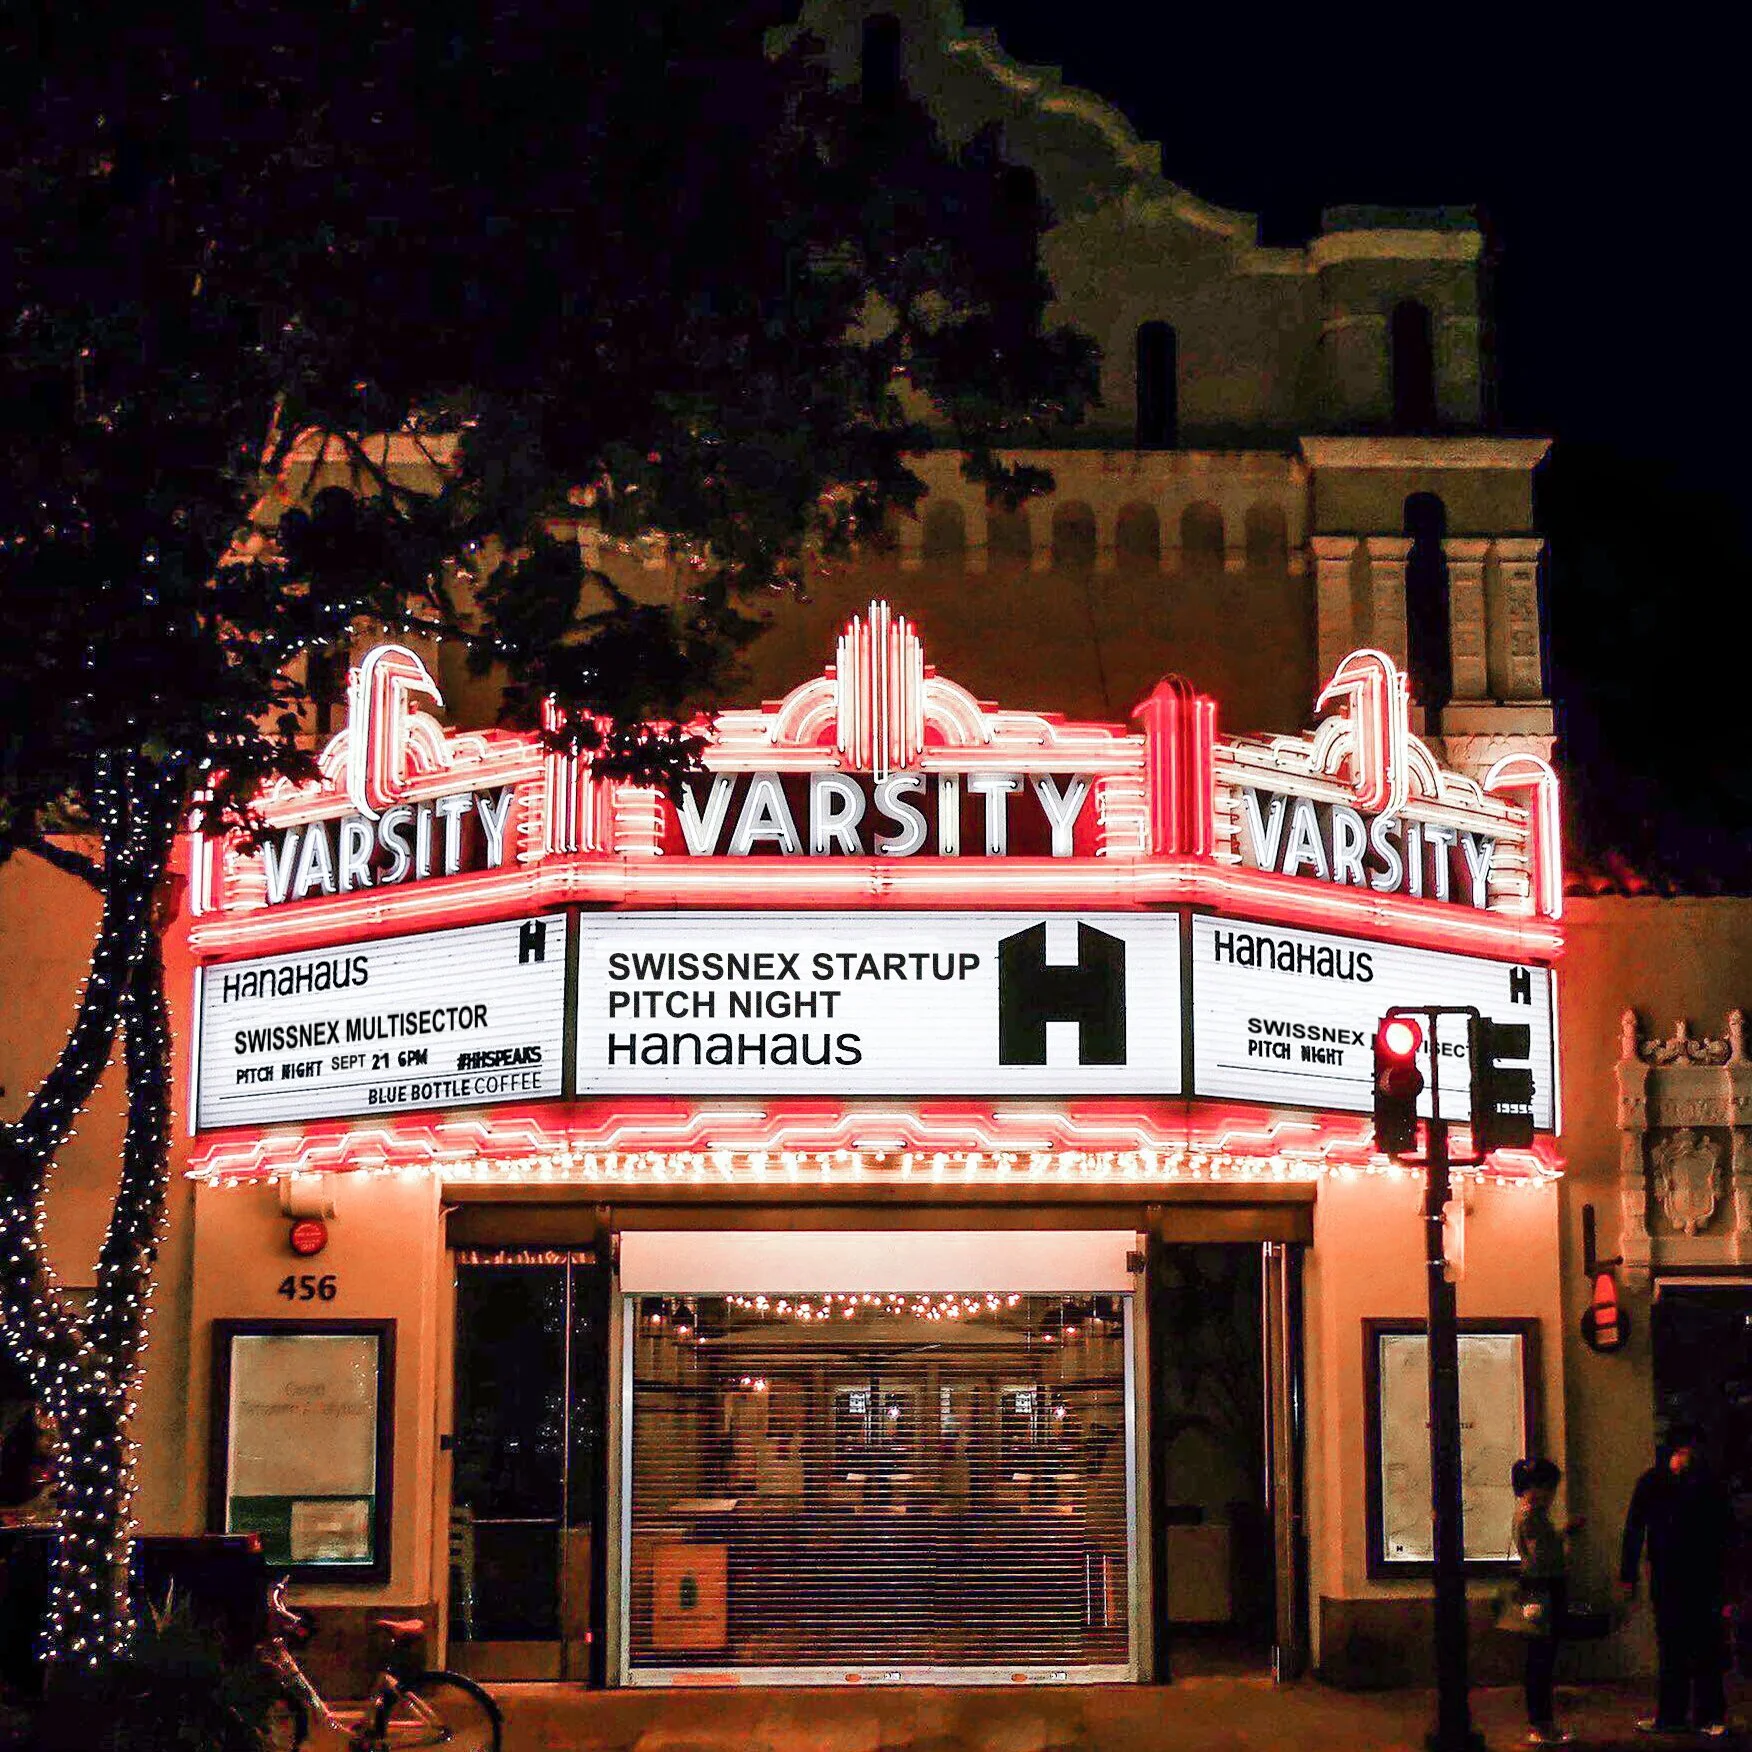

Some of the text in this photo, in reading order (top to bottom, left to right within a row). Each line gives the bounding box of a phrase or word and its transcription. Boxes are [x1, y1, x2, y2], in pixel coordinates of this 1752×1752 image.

[677, 771, 1094, 857] VARSITY
[262, 786, 515, 904] VARSITY
[1243, 788, 1497, 910] VARSITY
[608, 952, 980, 981] SWISSNEX STARTUP
[608, 990, 841, 1019] PITCH NIGHT
[234, 1004, 488, 1054] SWISSNEX MULTISECTOR
[1248, 1018, 1365, 1047] SWISSNEX
[236, 1049, 428, 1085] PITCH NIGHT SEPT 21 6PM
[1248, 1039, 1344, 1067] PITCH NIGHT
[368, 1072, 542, 1105] BLUE BOTTLE COFFEE
[278, 1274, 338, 1302] 456
